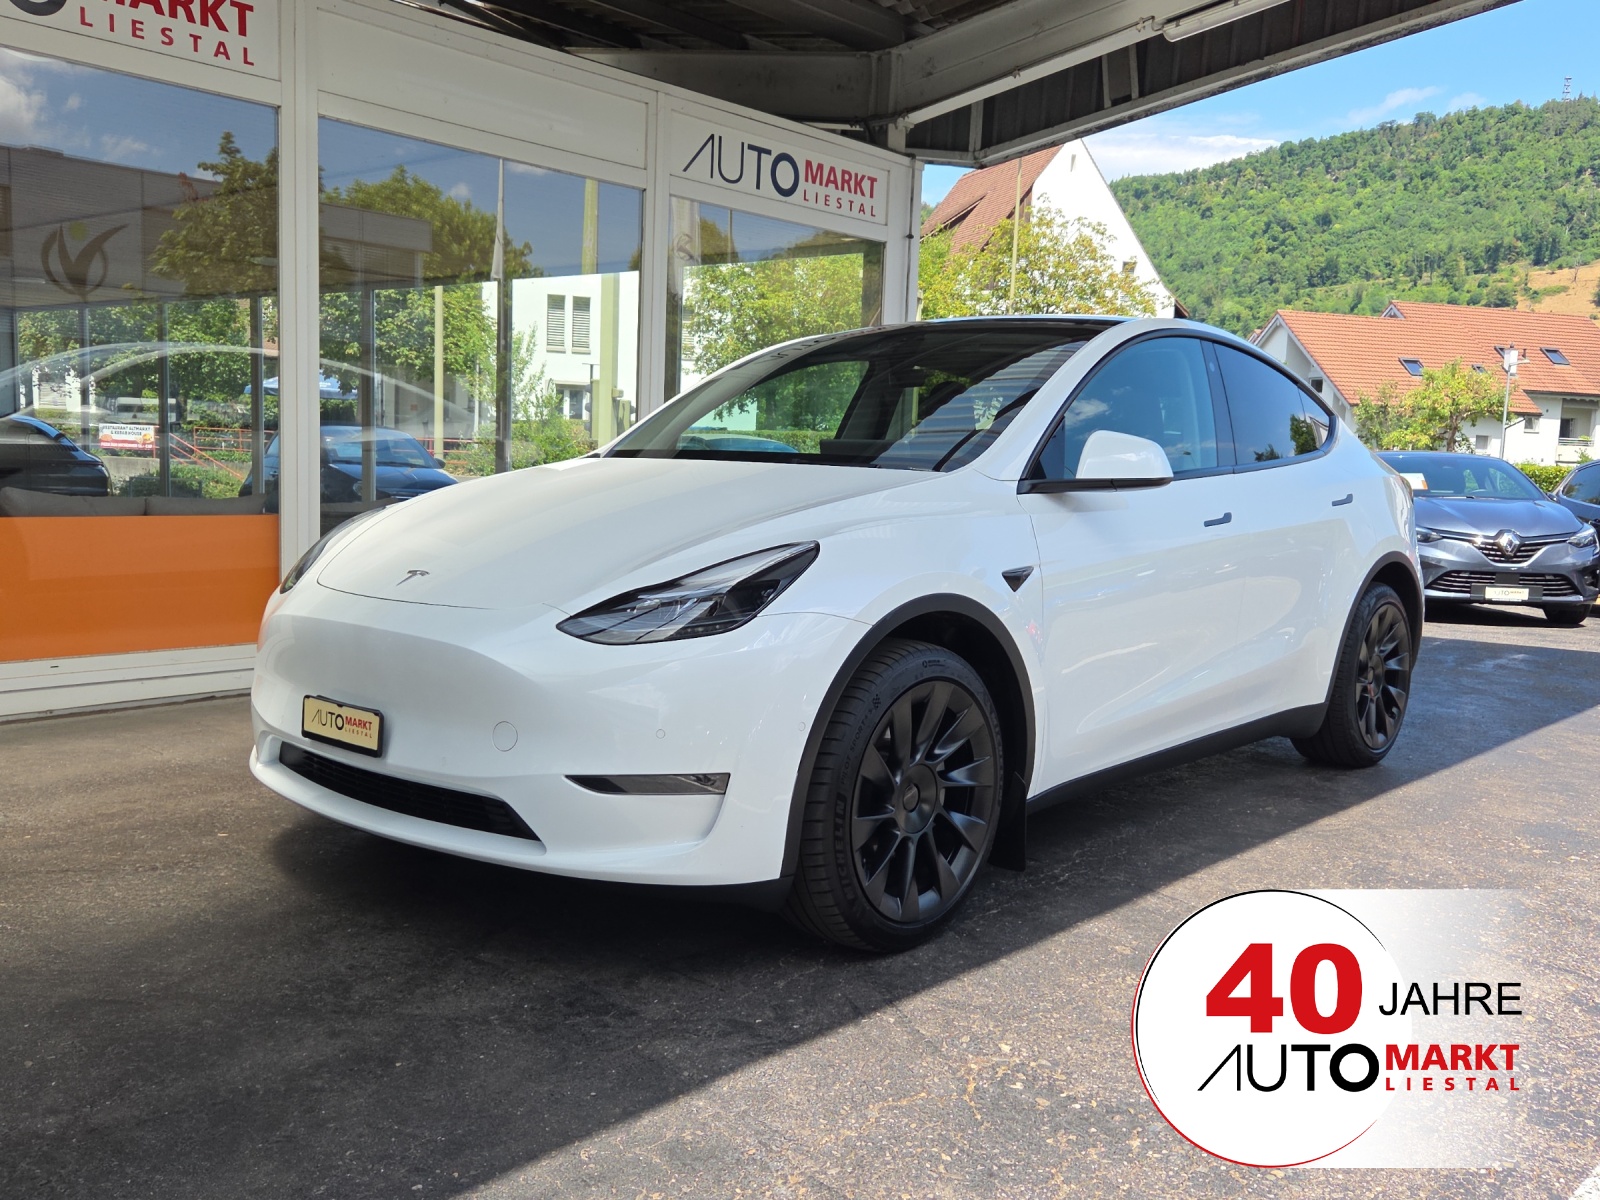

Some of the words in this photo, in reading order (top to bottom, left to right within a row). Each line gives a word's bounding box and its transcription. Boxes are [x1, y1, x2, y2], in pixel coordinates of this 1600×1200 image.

[97, 0, 254, 37] RKT
[79, 6, 254, 66] LIESTAL
[682, 133, 800, 198] AUTO
[804, 159, 878, 199] MARKT
[803, 189, 876, 217] LIESTAL
[311, 709, 345, 731] AUTO
[345, 715, 373, 731] MARKT
[345, 728, 373, 739] LIESTAL
[849, 719, 865, 752] SPORT
[840, 754, 851, 785] PILOT
[835, 799, 855, 900] MICHELIN
